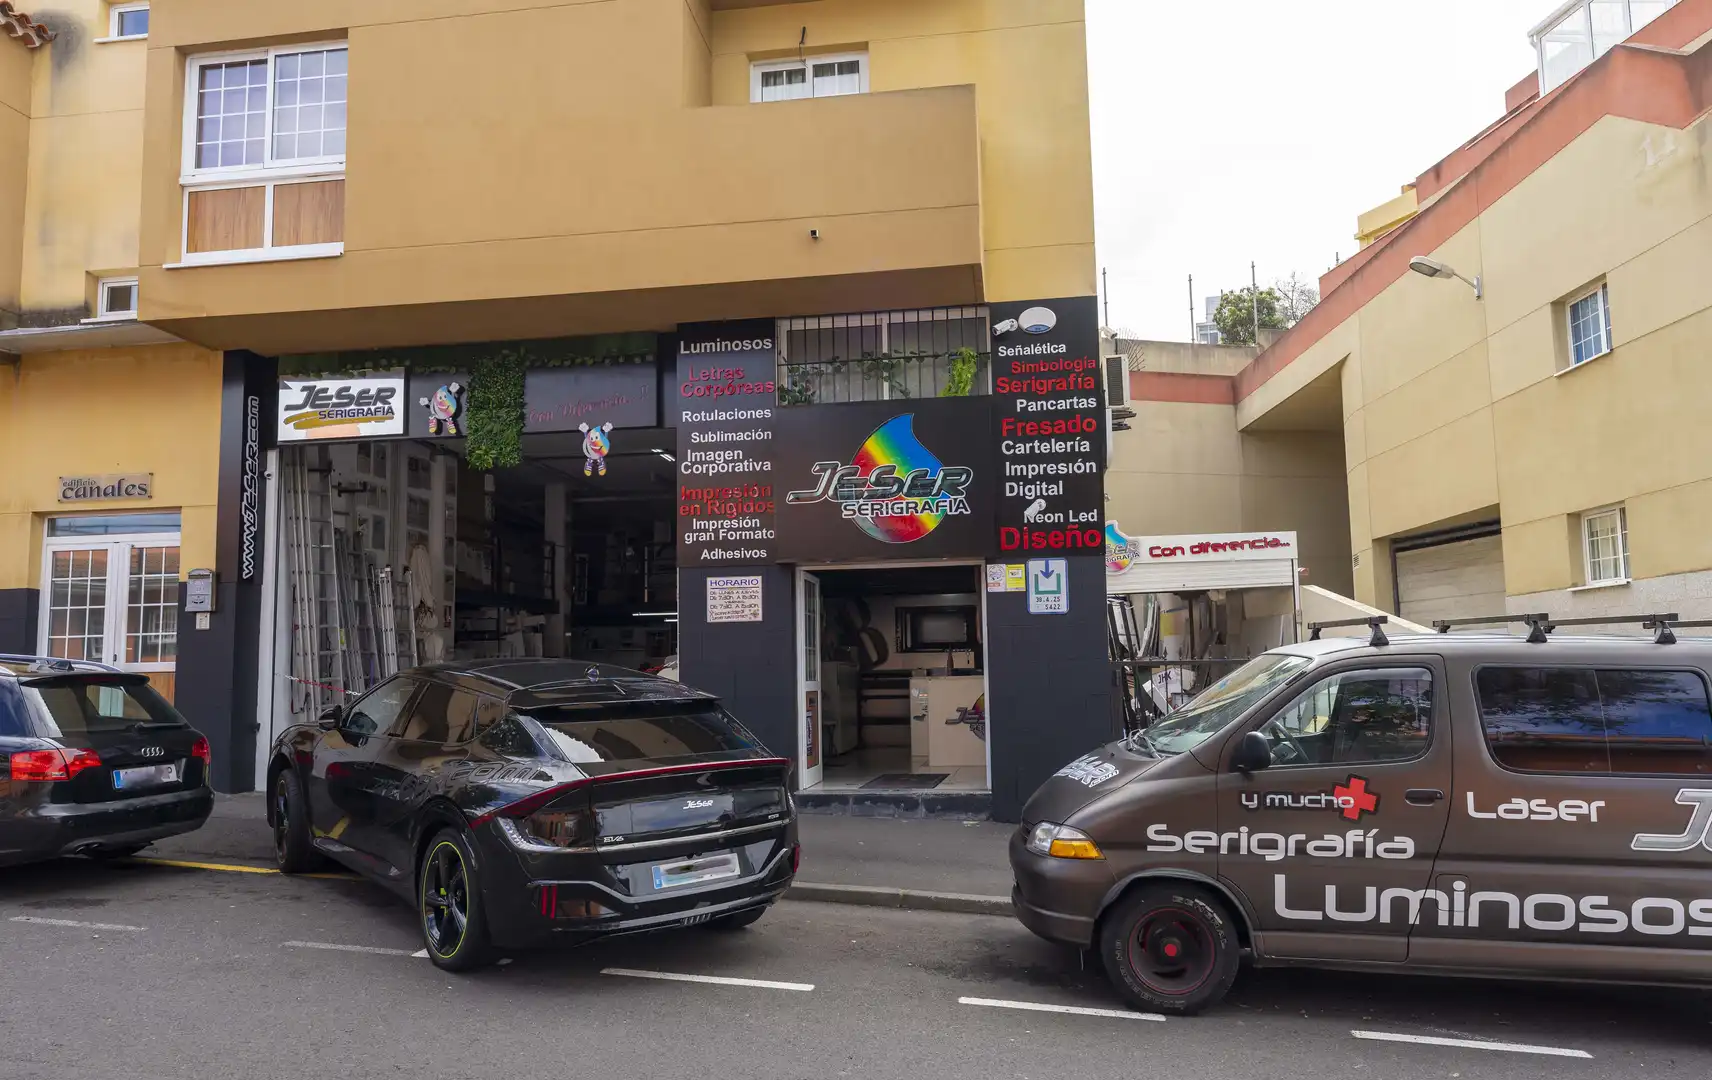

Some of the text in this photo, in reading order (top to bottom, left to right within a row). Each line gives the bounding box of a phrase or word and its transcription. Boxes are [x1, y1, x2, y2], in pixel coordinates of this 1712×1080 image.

[680, 338, 773, 354] Luminosos
[998, 342, 1067, 356] Señalética
[688, 363, 746, 382] Letras
[1011, 356, 1096, 374] Simbología
[680, 380, 776, 401] Corpóreas
[996, 373, 1095, 395] Serigrafía
[284, 385, 397, 411] JESER
[1016, 396, 1097, 412] Pancartas
[318, 406, 395, 419] SERIGRAFIA
[682, 408, 772, 422] Rotulaciones
[1001, 414, 1097, 437] Fresado
[691, 429, 772, 443] Sublimación
[1001, 436, 1090, 455] Cartelería
[687, 449, 743, 464] Imagen
[681, 458, 772, 476] Corporativa
[1005, 459, 1097, 479] Impresión
[62, 478, 96, 487] edificio
[62, 478, 148, 499] canales
[786, 461, 973, 504] JESER
[1005, 480, 1063, 499] Digital
[681, 483, 773, 503] Impresión
[680, 504, 701, 516] en
[842, 498, 971, 518] SERIGRAFIA
[1024, 509, 1098, 523] Neon Led
[693, 516, 760, 531] Impresión
[684, 528, 775, 544] gran Formato
[1000, 524, 1102, 551] Diseño
[701, 548, 767, 560] Adhesivos
[1149, 545, 1185, 558] Con
[683, 800, 713, 809] JESER
[1241, 793, 1354, 808] y mucho
[1467, 791, 1605, 822] Laser
[1146, 823, 1415, 861] Serigrafía
